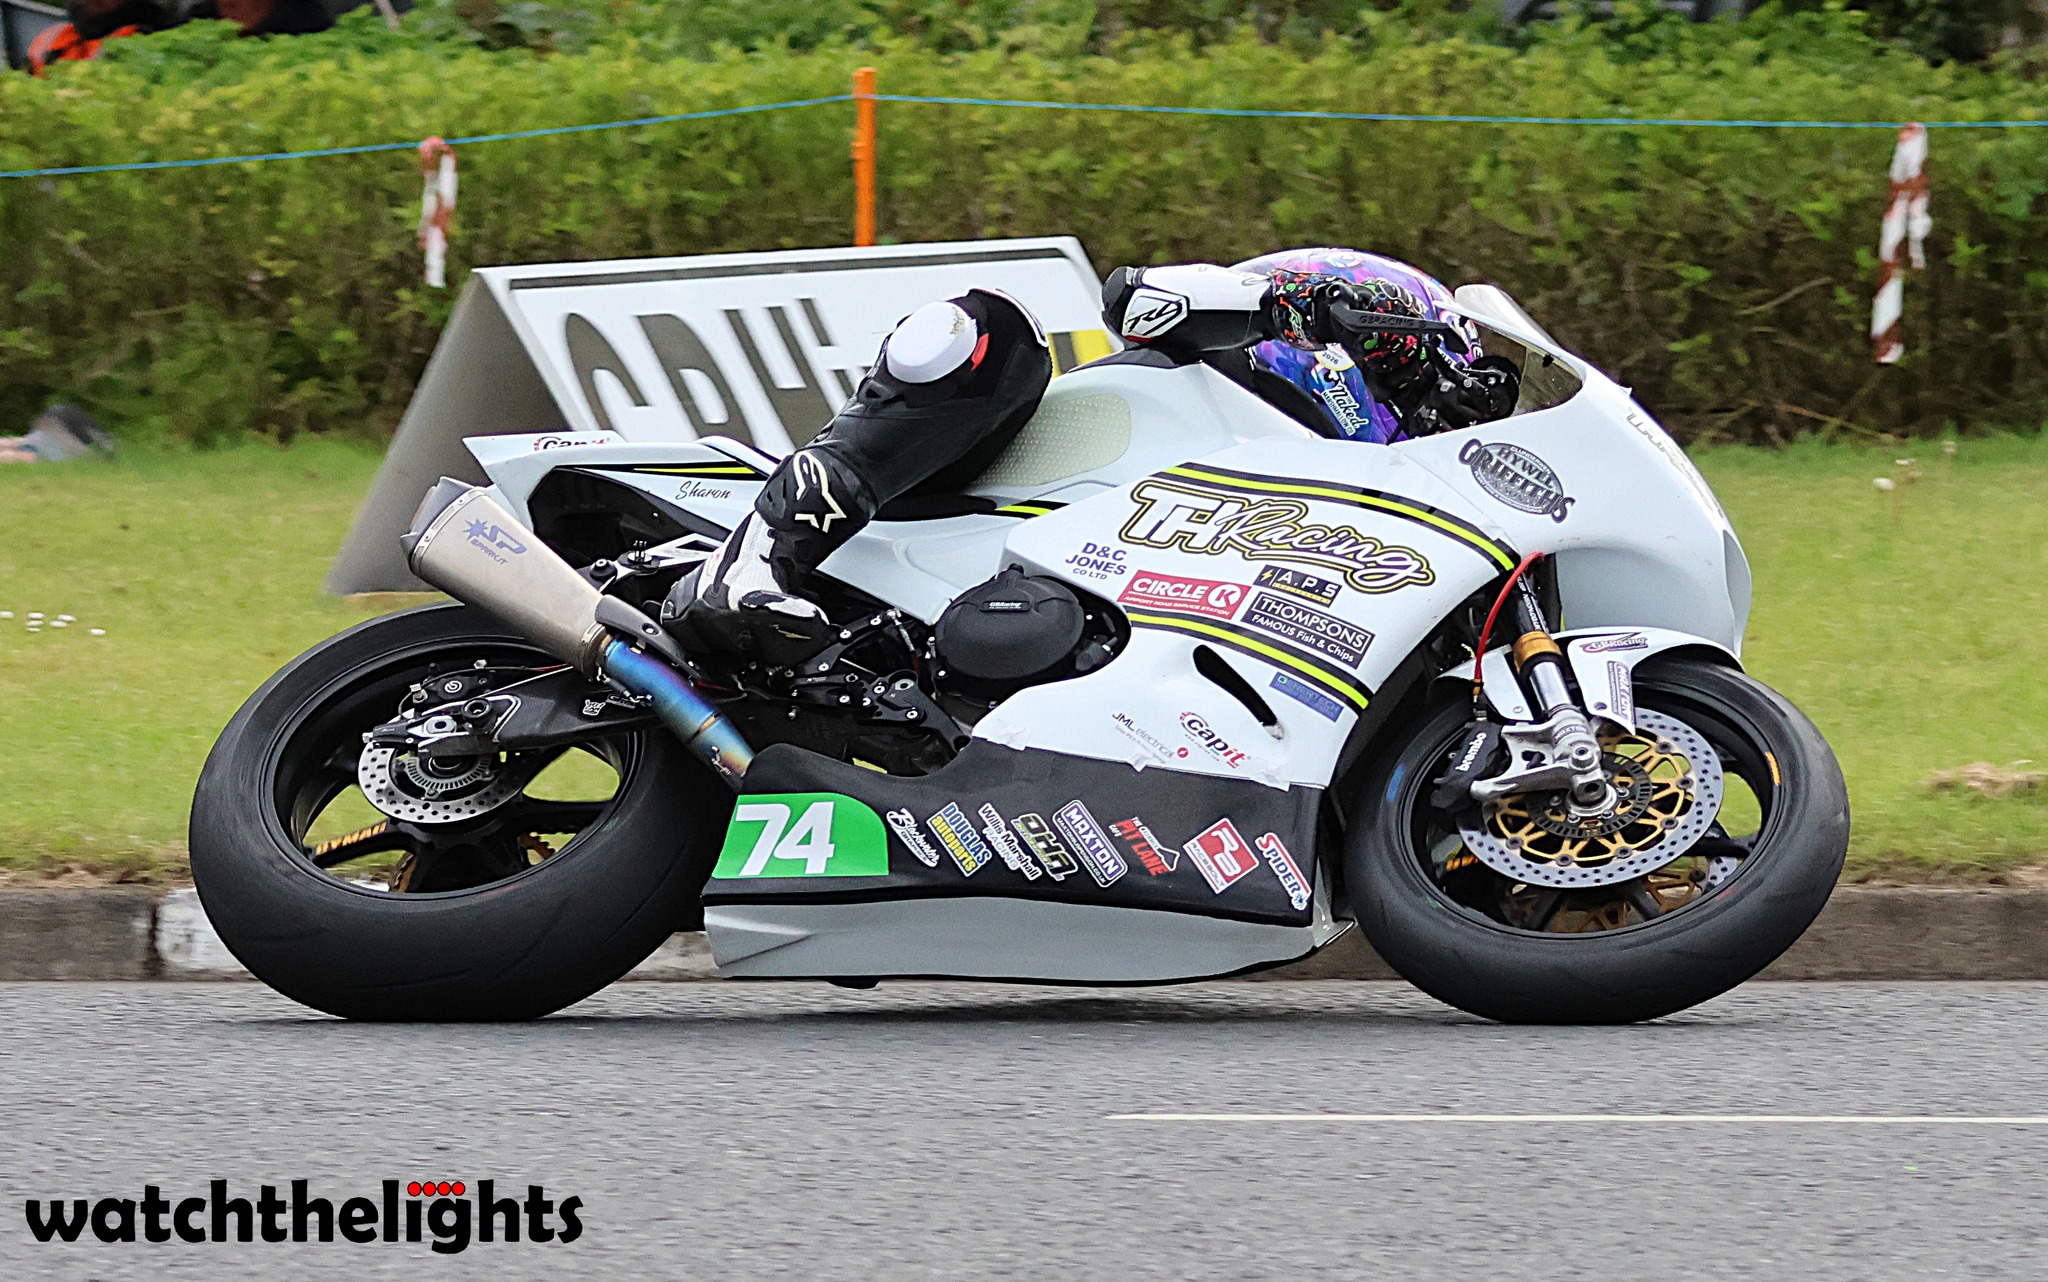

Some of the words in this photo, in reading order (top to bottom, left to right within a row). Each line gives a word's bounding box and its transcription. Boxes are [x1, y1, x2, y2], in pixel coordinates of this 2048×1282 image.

[1329, 384, 1368, 428] Naked
[675, 480, 731, 500] Sharon
[1458, 438, 1576, 523] GRIFFITHS
[1065, 554, 1127, 575] JONES
[1081, 542, 1127, 561] D&C
[1088, 571, 1107, 580] LTD
[1132, 578, 1209, 599] CIRCLE
[1212, 586, 1239, 607] K
[1200, 605, 1230, 616] STATION
[1260, 598, 1365, 648] THOMPSONS
[1251, 614, 1296, 636] FAMOUS
[1296, 630, 1316, 645] Fish
[1316, 639, 1326, 649] &
[1327, 643, 1355, 662] Chips
[1112, 713, 1135, 732] JML
[1455, 732, 1487, 771] brembo
[735, 801, 835, 876] 74
[931, 815, 976, 872] autoparts
[942, 804, 990, 864] DOUGLAS
[985, 827, 1019, 869] RACING
[1002, 832, 1039, 877] Marshall
[1066, 808, 1119, 875] MAXTON
[1114, 819, 1144, 840] PIT
[1131, 841, 1169, 877] LANE
[1190, 842, 1226, 887] RACEBOLT
[1258, 834, 1304, 894] SPIDER
